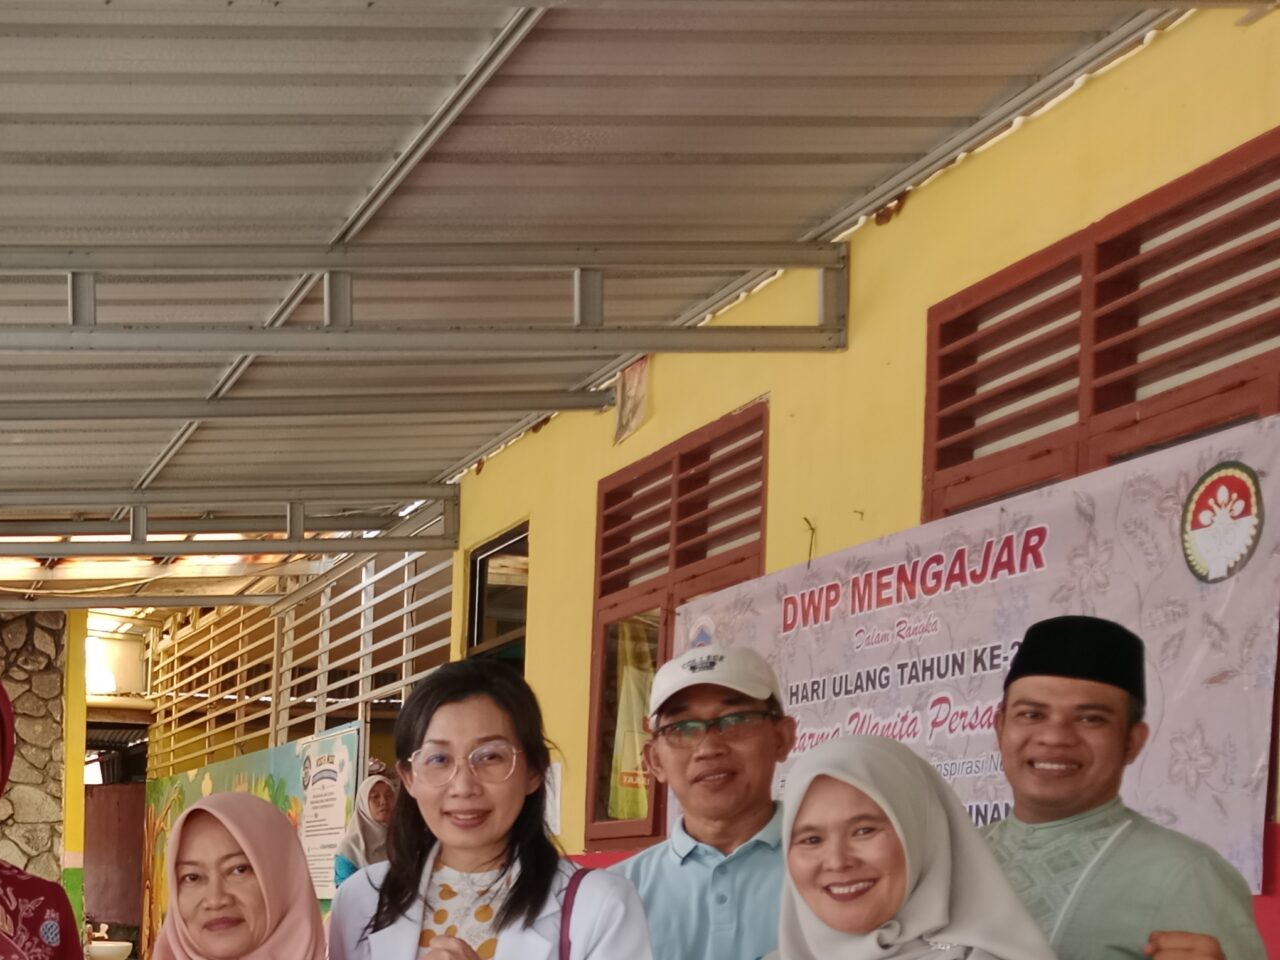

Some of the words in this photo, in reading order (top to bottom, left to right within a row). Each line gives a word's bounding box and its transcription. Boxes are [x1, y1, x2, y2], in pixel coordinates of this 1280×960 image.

[782, 583, 841, 634] DWP
[850, 525, 1048, 615] MENGAJAR
[856, 627, 890, 649] Dalam
[896, 612, 938, 641] Rangka
[789, 679, 826, 705] HARI
[832, 666, 890, 698] ULANG
[898, 651, 965, 686] TAHUN
[848, 709, 919, 741] Wanita
